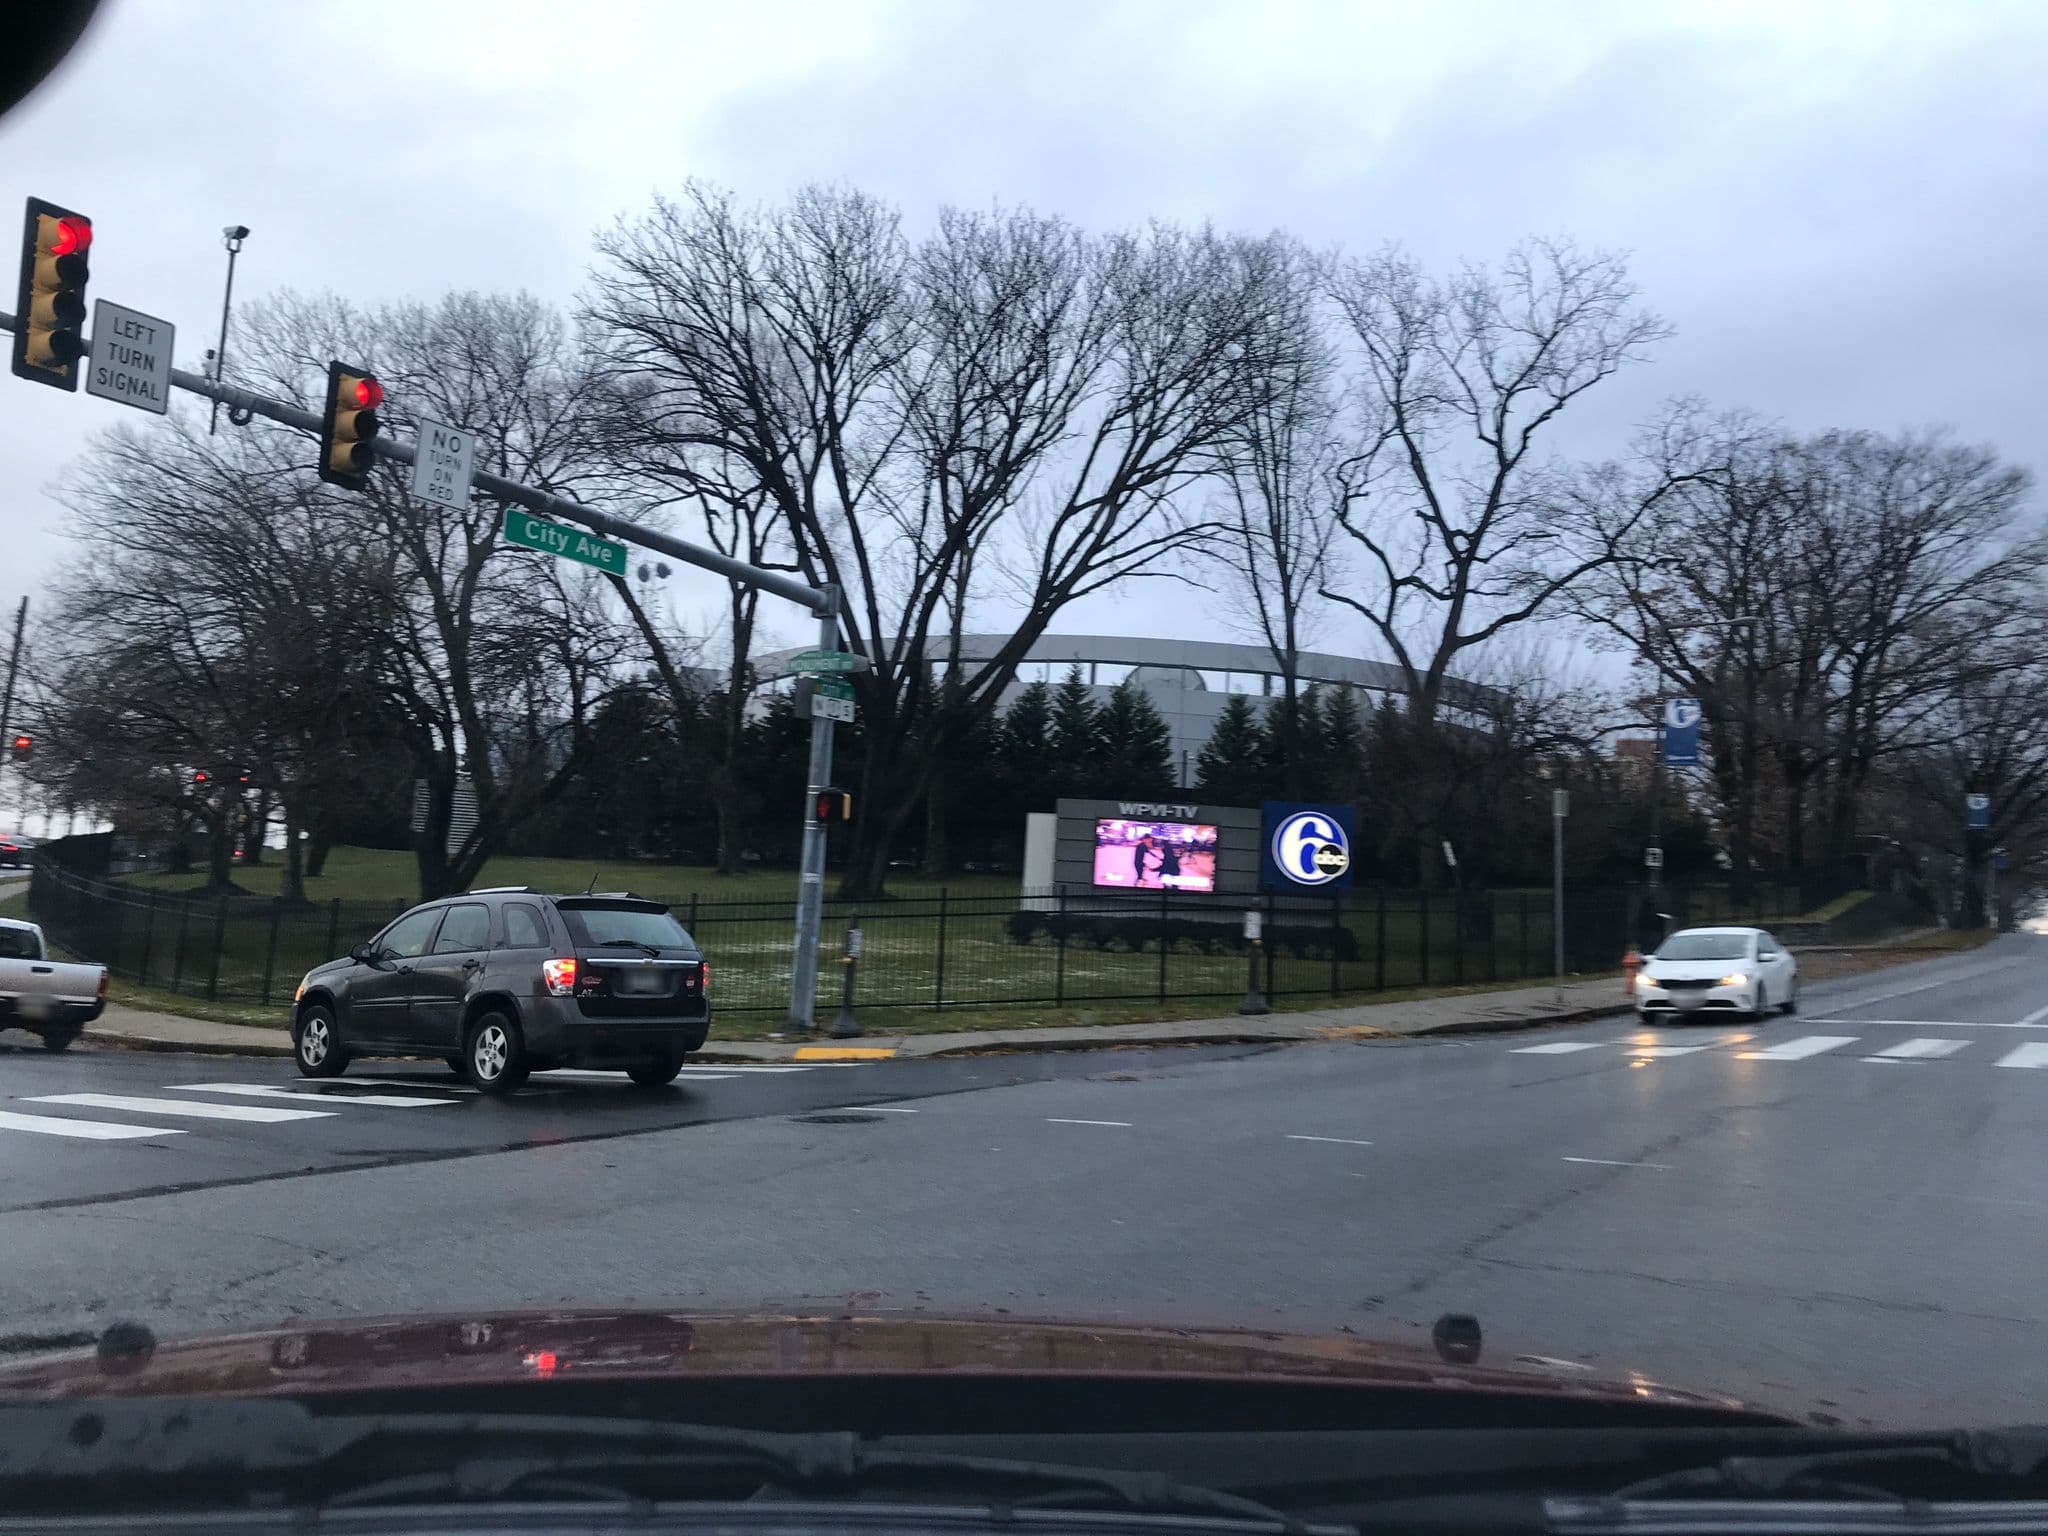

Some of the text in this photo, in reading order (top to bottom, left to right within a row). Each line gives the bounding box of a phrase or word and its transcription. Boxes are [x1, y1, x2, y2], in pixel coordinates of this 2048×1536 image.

[113, 316, 156, 345] LEFT
[108, 342, 155, 372] TURN
[97, 367, 159, 401] SIGNAL
[432, 429, 462, 453] NO
[429, 449, 462, 471] TURN
[434, 468, 453, 484] ON
[428, 483, 454, 501] RED
[525, 521, 612, 562] City Ave
[1119, 802, 1199, 818] WPVI-TV
